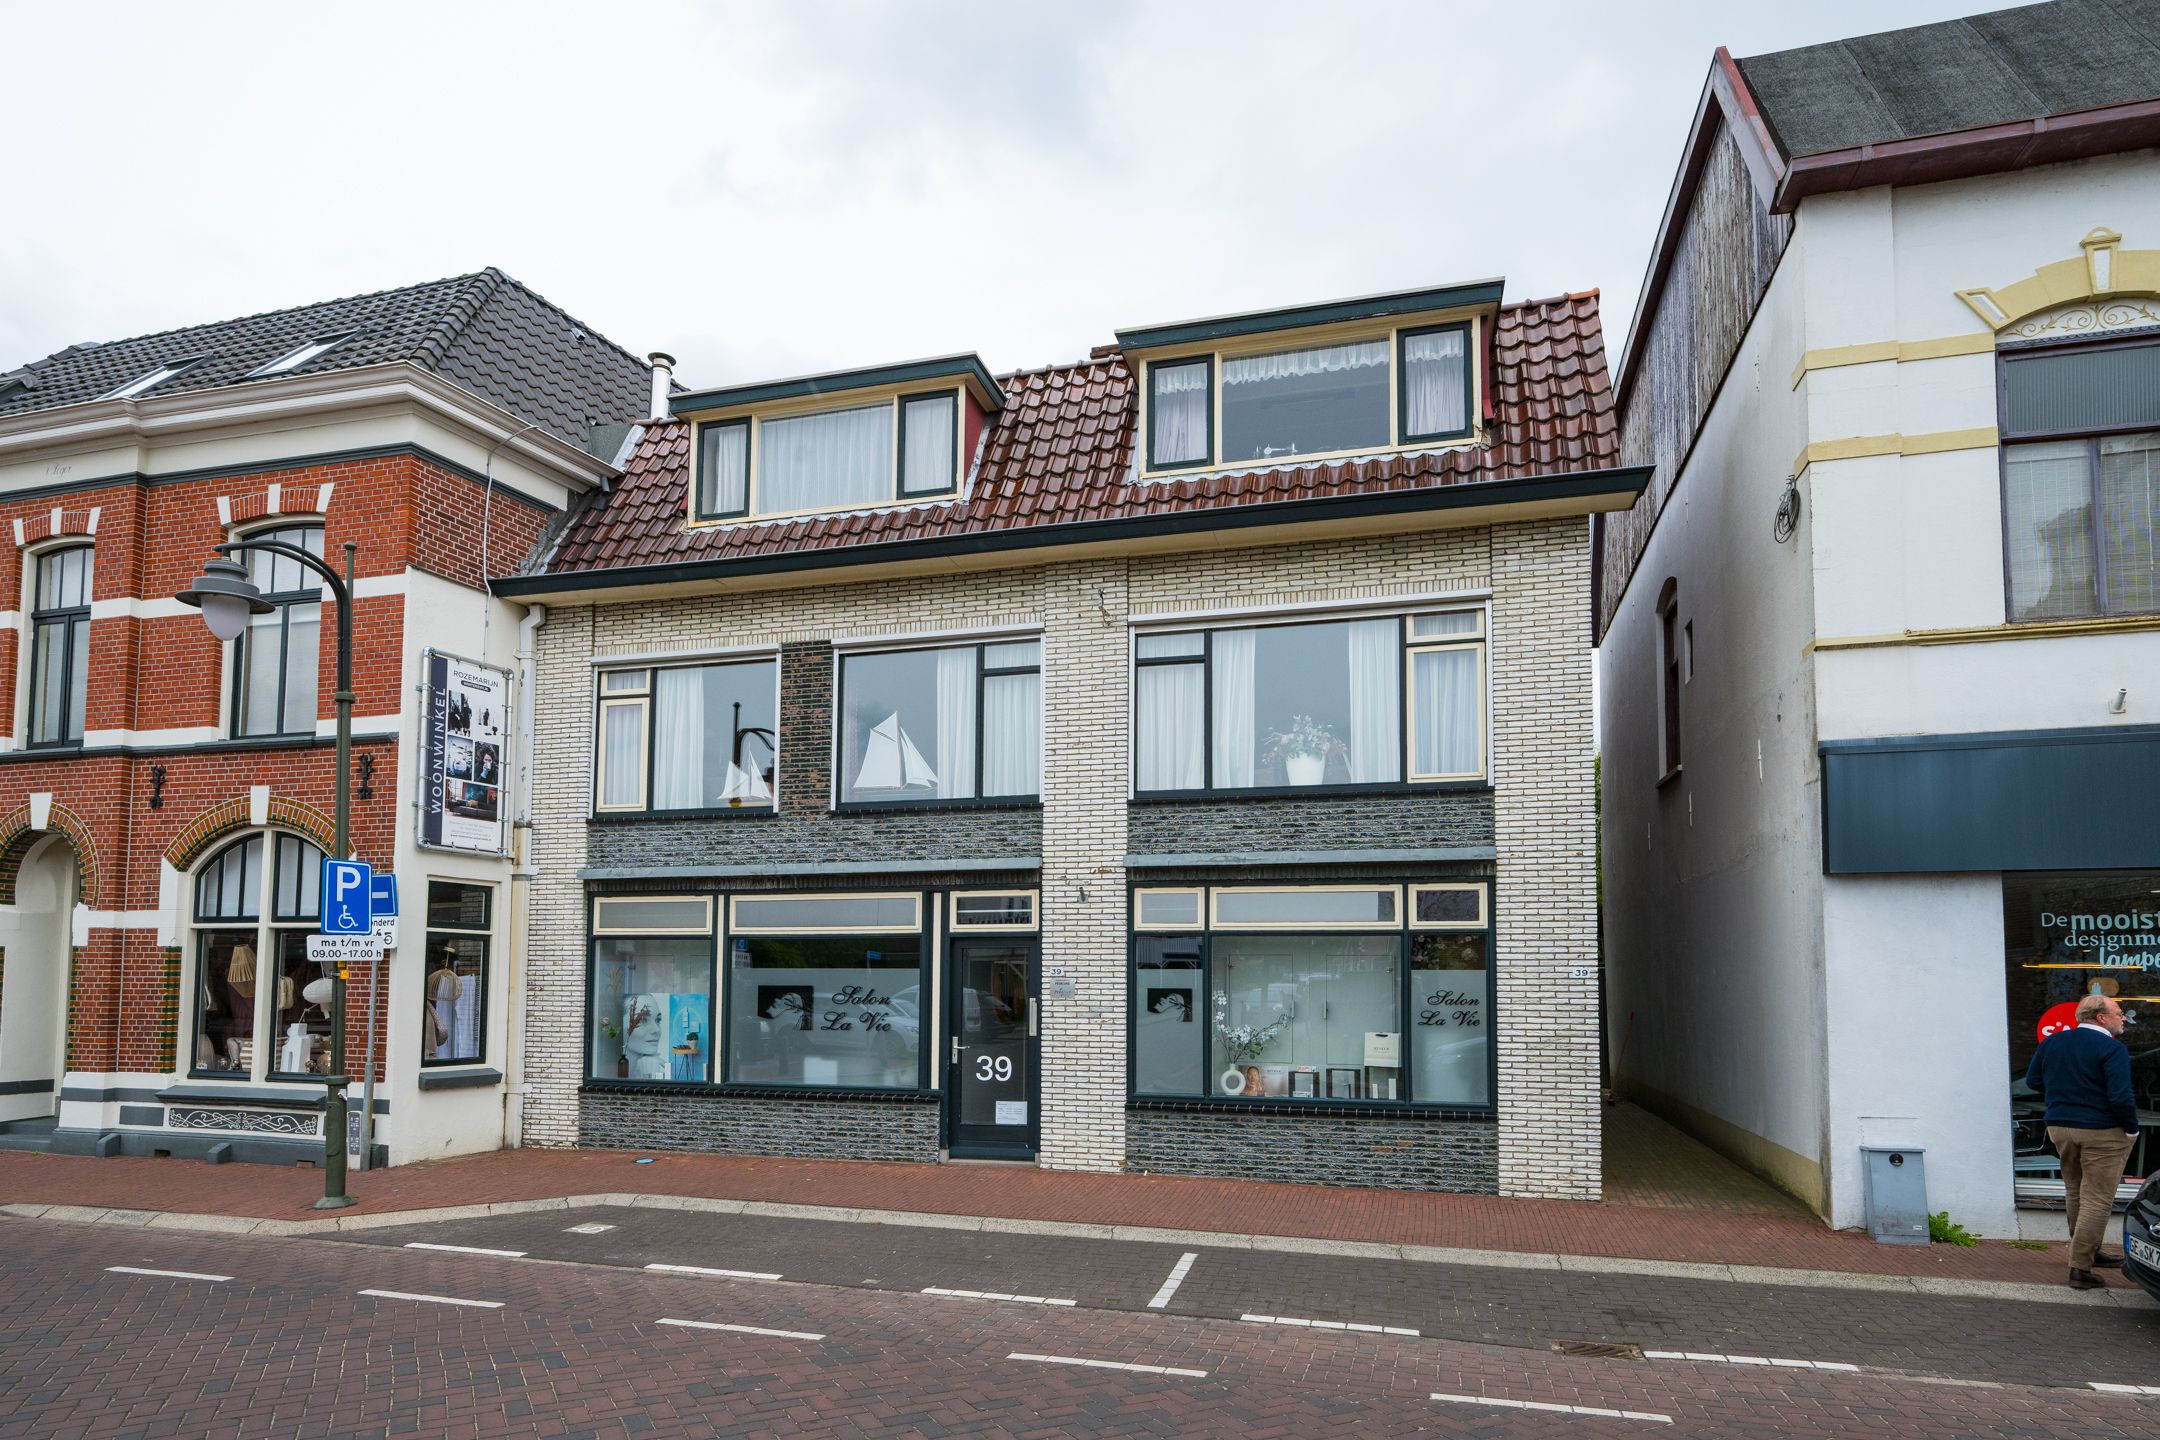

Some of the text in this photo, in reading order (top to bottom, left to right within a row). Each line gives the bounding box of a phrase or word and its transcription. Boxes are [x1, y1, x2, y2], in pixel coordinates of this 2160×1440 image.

[453, 670, 499, 687] ROZEMARIJN
[431, 687, 446, 814] WOONWINKEL
[336, 865, 361, 902] P
[2041, 912, 2068, 928] De
[321, 938, 375, 947] ma t/m vr
[2064, 930, 2160, 952] designm
[376, 949, 382, 958] h
[1574, 968, 1589, 977] 39
[831, 985, 892, 1006] Salon
[1427, 989, 1480, 1006] Salon
[820, 1011, 892, 1032] La Vie
[1417, 1010, 1481, 1027] La Vie
[975, 1055, 1013, 1082] 39
[2129, 1237, 2139, 1255] GE
